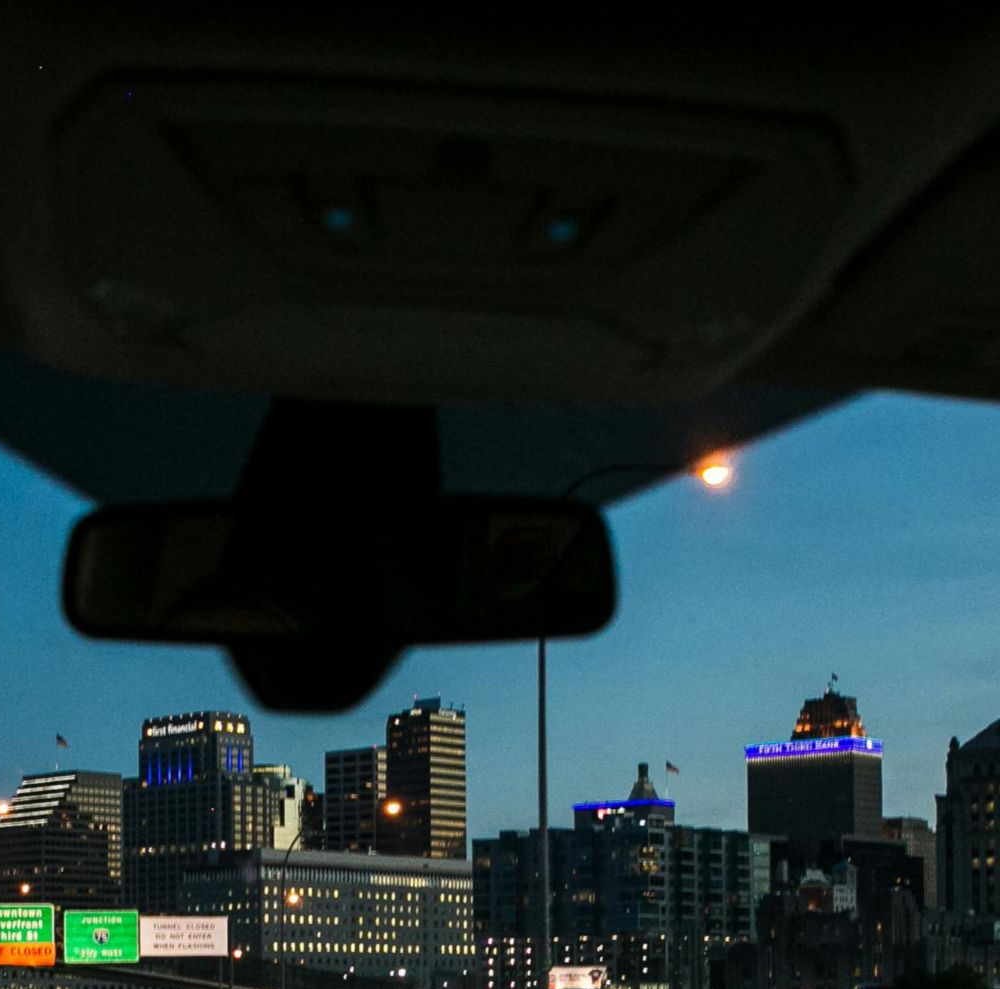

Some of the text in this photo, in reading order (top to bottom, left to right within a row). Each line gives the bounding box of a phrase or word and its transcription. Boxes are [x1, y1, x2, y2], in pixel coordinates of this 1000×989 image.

[152, 720, 197, 737] first financial
[81, 916, 122, 925] JUNCTION
[154, 922, 216, 931] TUNNEL CLOSED
[26, 930, 38, 941] St
[156, 932, 212, 940] DO NOT ENTER
[154, 942, 215, 950] WHEN FLASHING
[10, 946, 52, 957] CLOSED
